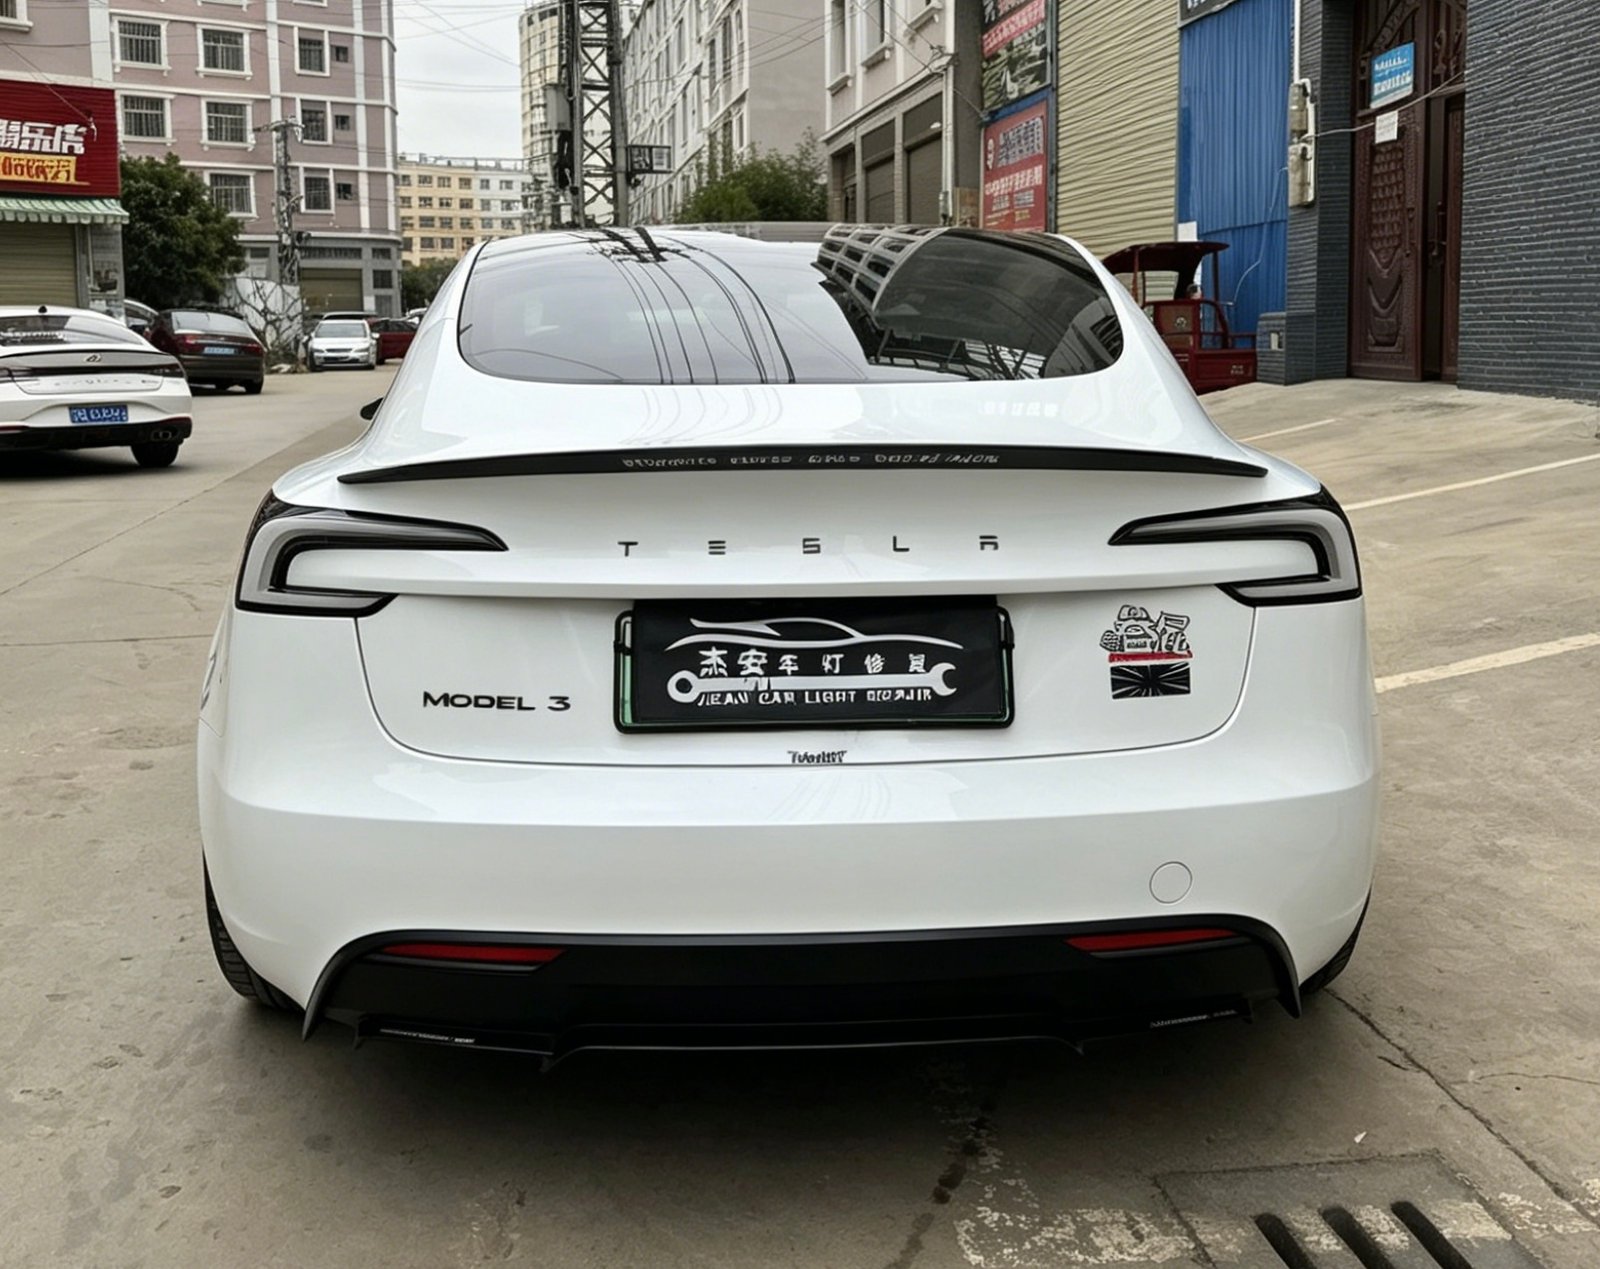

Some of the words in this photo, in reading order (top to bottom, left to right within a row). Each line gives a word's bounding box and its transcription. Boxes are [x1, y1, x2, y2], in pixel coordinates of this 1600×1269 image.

[618, 535, 999, 557] TESLA
[423, 691, 536, 711] MODEL
[547, 696, 571, 712] 3
